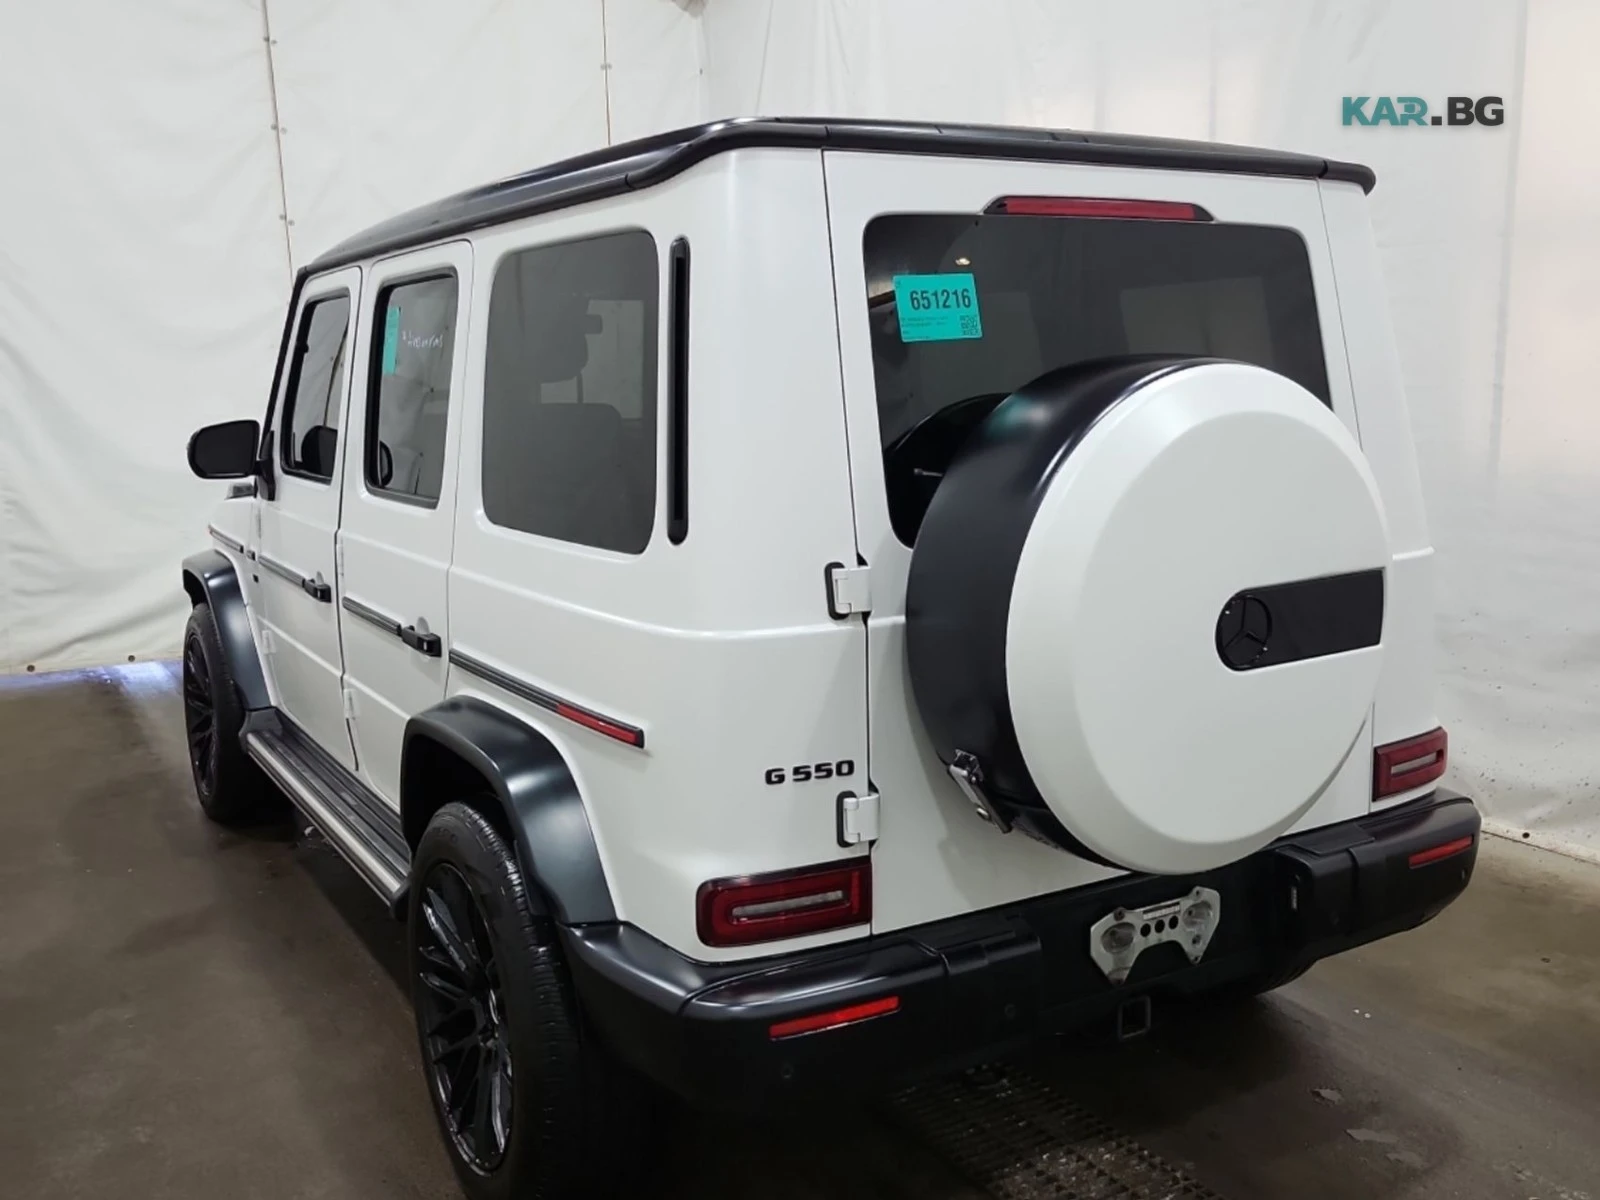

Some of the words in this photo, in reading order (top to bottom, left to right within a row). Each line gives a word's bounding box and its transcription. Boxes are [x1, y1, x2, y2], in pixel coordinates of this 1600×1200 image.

[910, 288, 971, 311] 651216
[765, 768, 785, 785] G
[792, 759, 854, 782] 550
